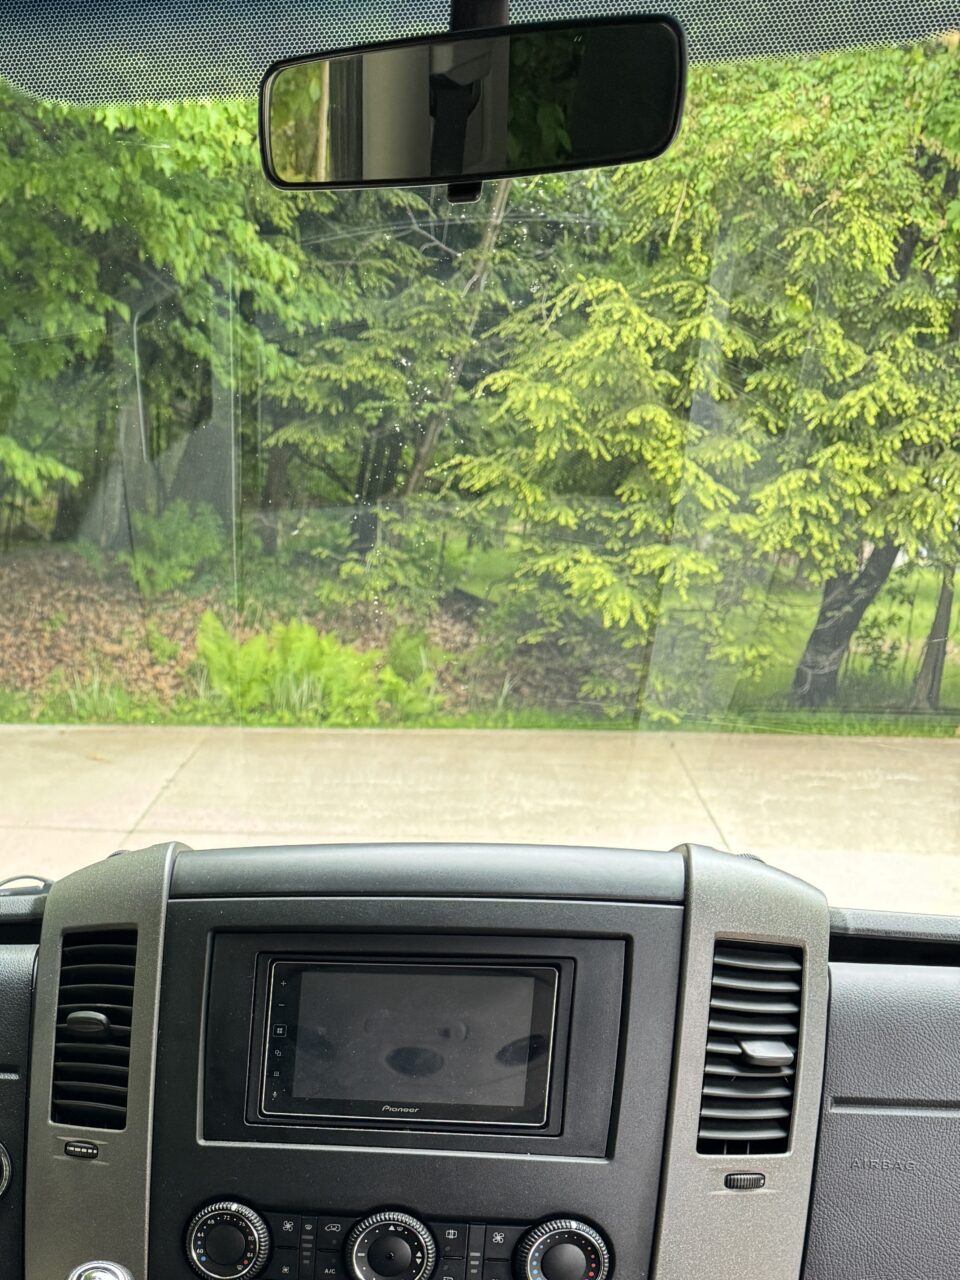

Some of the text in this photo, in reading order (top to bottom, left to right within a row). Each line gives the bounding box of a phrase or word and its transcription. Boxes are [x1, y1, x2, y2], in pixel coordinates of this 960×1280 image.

[381, 1104, 420, 1113] Pioneer
[850, 1158, 916, 1171] AIRBAG
[324, 1267, 336, 1275] A/C
